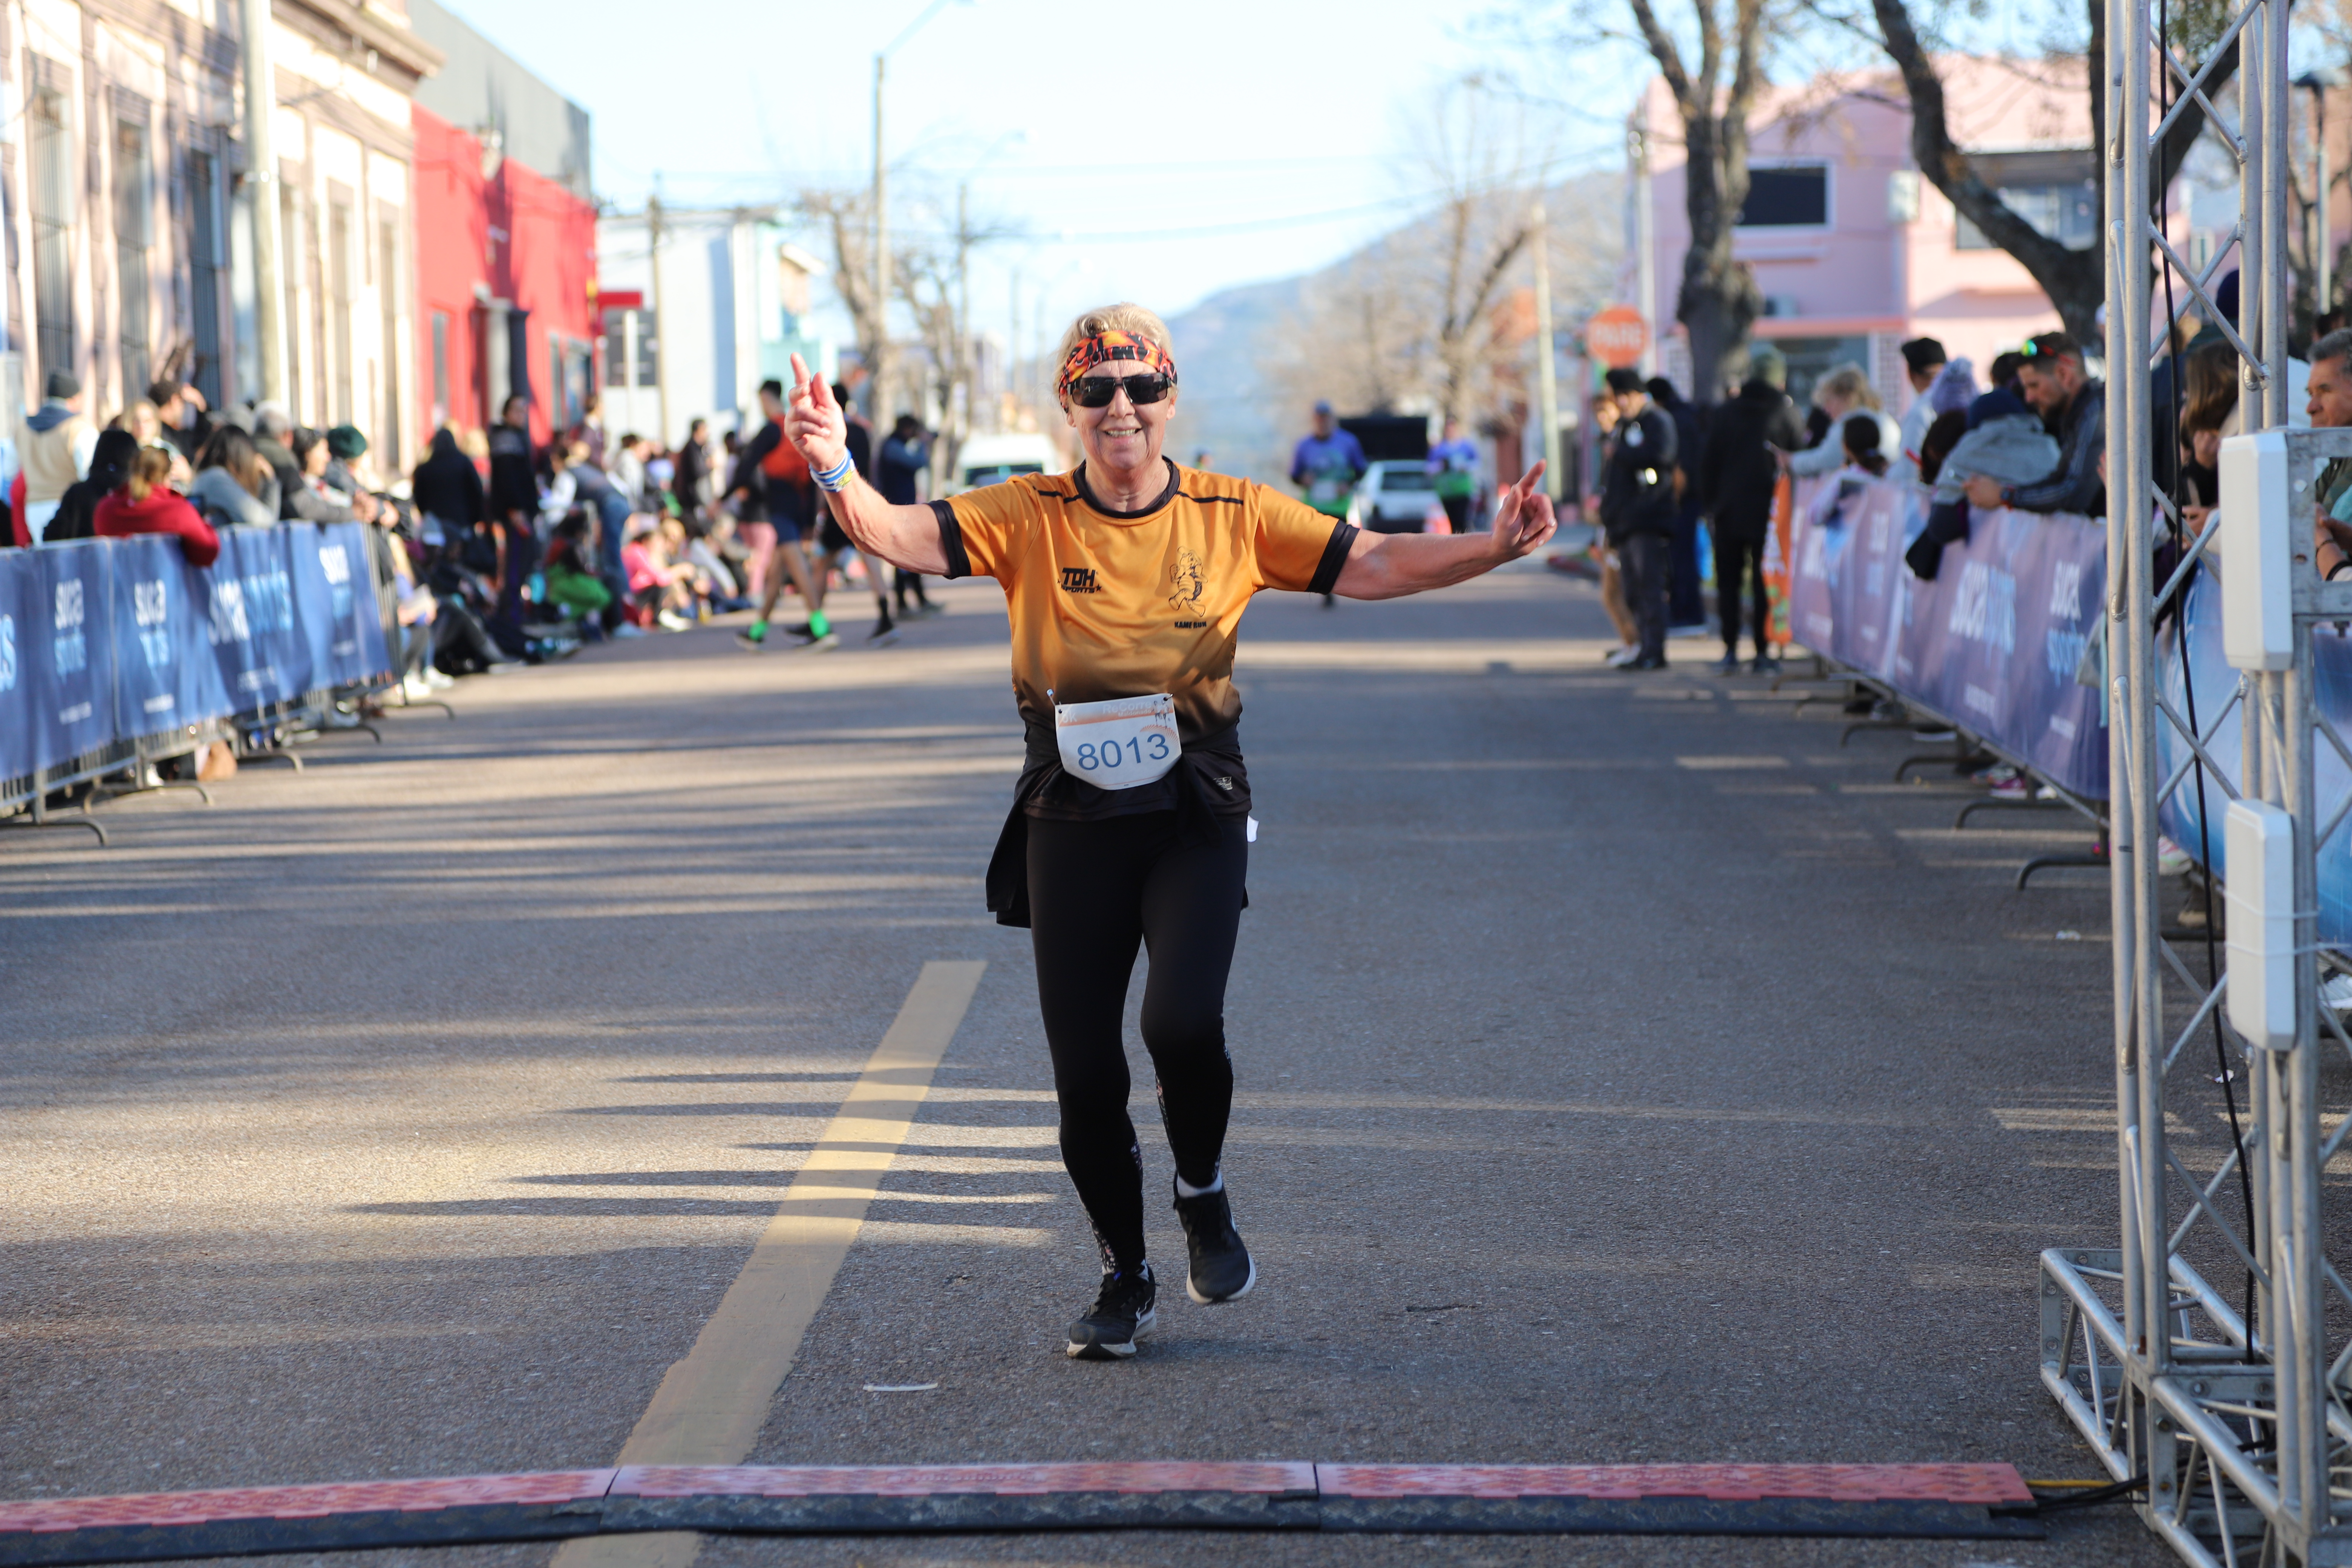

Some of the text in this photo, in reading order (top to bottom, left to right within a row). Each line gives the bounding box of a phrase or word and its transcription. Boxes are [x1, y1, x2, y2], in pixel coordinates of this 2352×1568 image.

[1062, 567, 1096, 586] TDH
[1102, 701, 1152, 714] ReCorre
[1118, 709, 1152, 717] Maldonado
[1077, 733, 1169, 770] 8013
